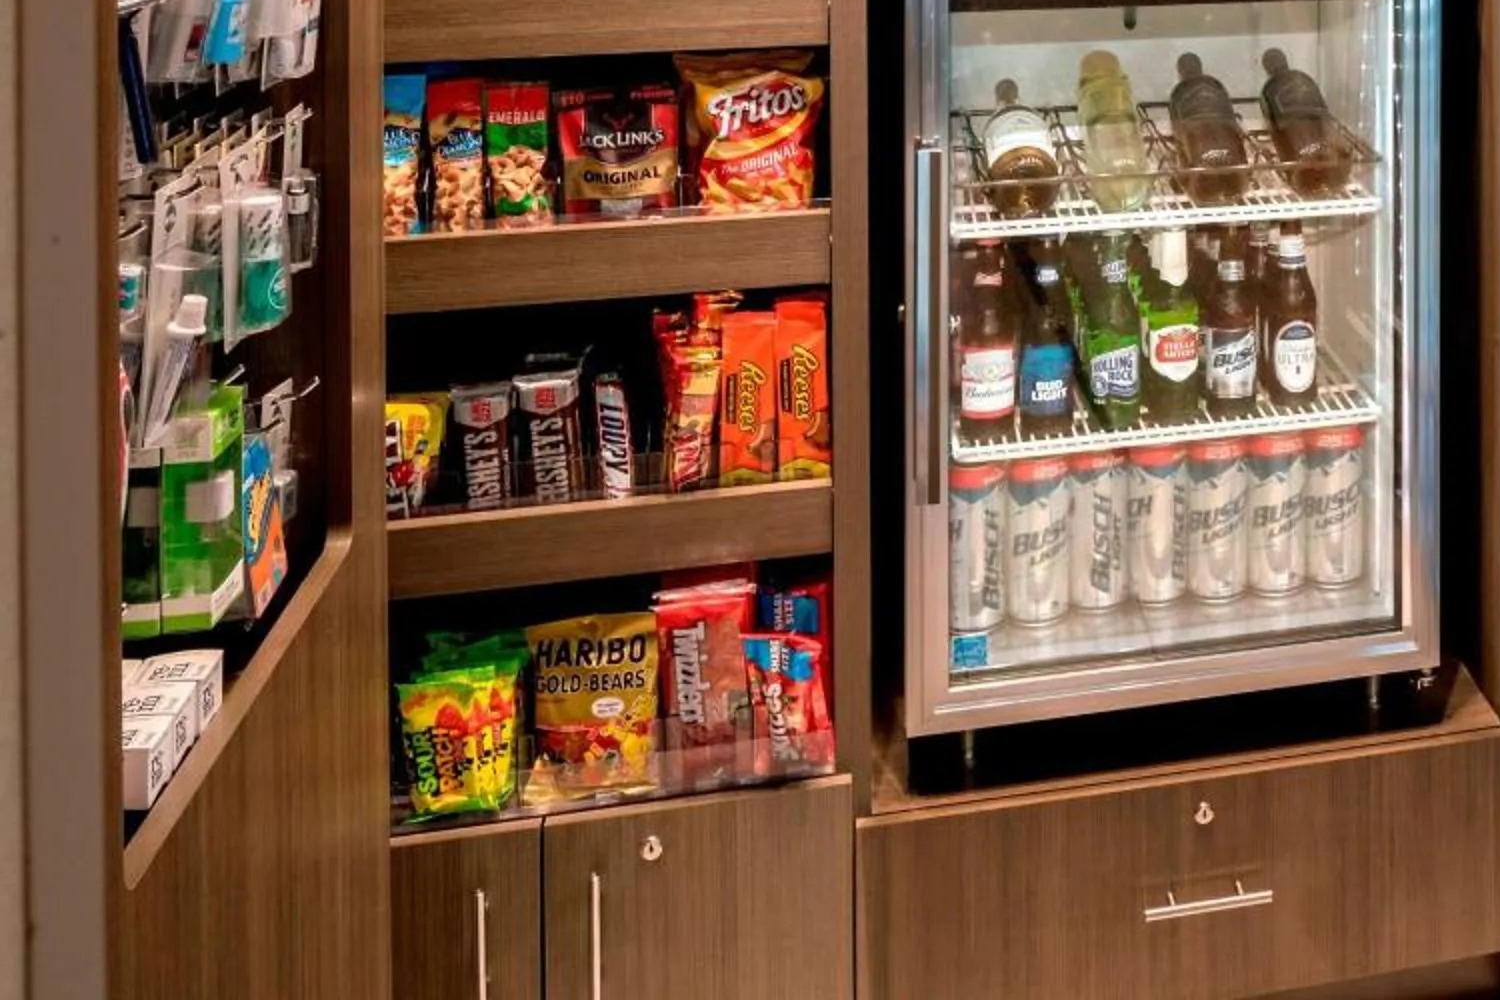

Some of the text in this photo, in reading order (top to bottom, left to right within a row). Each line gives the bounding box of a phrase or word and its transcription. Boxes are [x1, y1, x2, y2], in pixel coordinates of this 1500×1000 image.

[488, 109, 545, 124] EMERALD
[707, 80, 806, 139] Fritos
[582, 166, 663, 184] ORIGINAL
[1035, 379, 1063, 390] BUD
[1108, 370, 1133, 382] ROCK
[1031, 387, 1068, 401] LIGHT
[536, 634, 647, 669] HARIBO
[536, 669, 646, 694] GOLD-BEARS
[672, 621, 711, 724] Twizzlers
[412, 729, 438, 796] SOUR
[433, 727, 458, 795] PATCH
